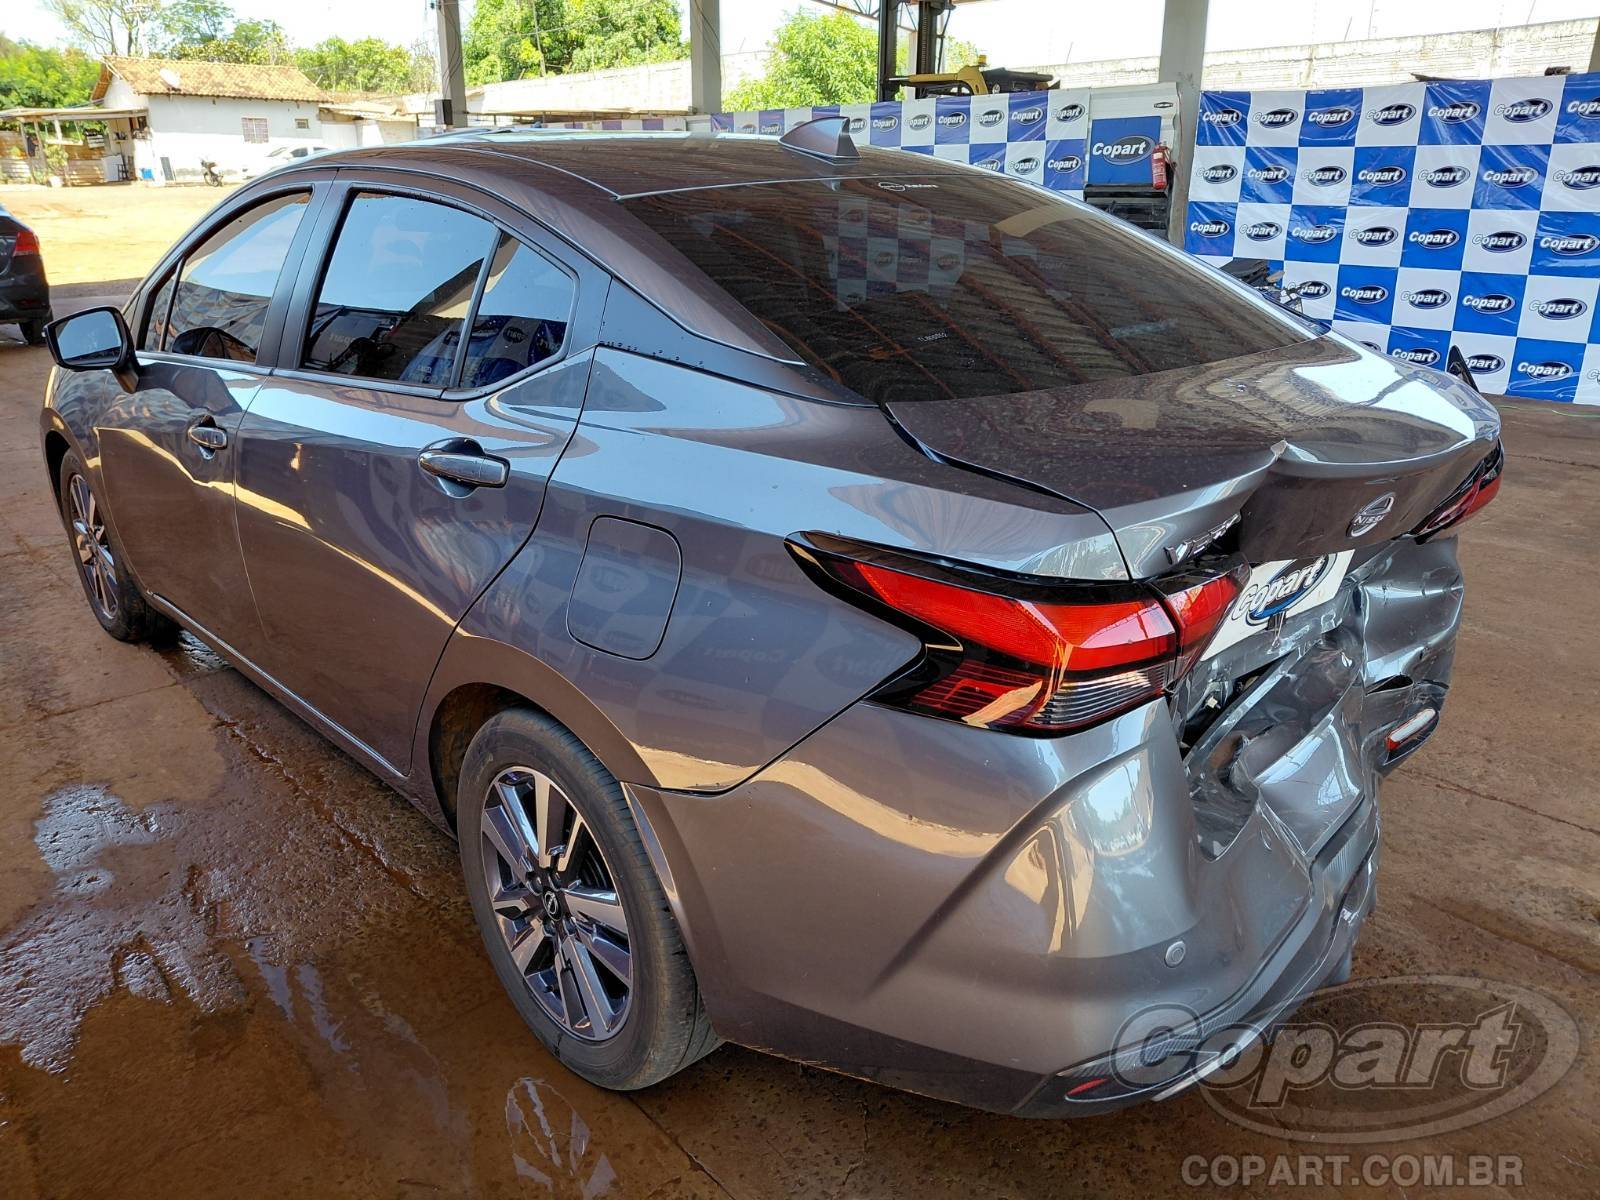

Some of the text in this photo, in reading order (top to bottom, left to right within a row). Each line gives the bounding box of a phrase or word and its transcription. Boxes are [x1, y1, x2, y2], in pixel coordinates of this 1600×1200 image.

[1011, 110, 1040, 123] Copart
[1052, 107, 1080, 120] Copart
[1202, 110, 1237, 124] Copart
[1253, 110, 1291, 124] Copart
[1308, 110, 1349, 124] Copart
[1366, 107, 1409, 122] Copart
[1428, 105, 1474, 121] Copart
[1494, 102, 1545, 119] Copart
[873, 119, 896, 129] Copart
[905, 118, 929, 128] Copart
[938, 114, 964, 126] Copart
[975, 112, 1003, 124] Copart
[1093, 141, 1146, 158] Copart
[1008, 158, 1039, 171] Copart
[1048, 157, 1078, 170] Copart
[1196, 167, 1232, 181] Copart
[1248, 166, 1285, 181] Copart
[1302, 167, 1341, 182] Copart
[1358, 168, 1400, 182] Copart
[1418, 169, 1462, 184] Copart
[1483, 169, 1531, 184] Copart
[1553, 169, 1600, 184] Copar
[1190, 222, 1225, 235] Copart
[1239, 223, 1276, 238] Copart
[1291, 225, 1332, 240] Copart
[1349, 228, 1392, 242] Copart
[1409, 230, 1453, 244] Copart
[1472, 233, 1519, 248] Copart
[1540, 236, 1593, 252] Copart
[1341, 286, 1383, 300] Copart
[1401, 290, 1445, 304] Copart
[1463, 295, 1509, 309] Copart
[1529, 300, 1579, 316] Copart
[1392, 348, 1435, 361] Copart
[1517, 361, 1567, 377] Copart
[1231, 554, 1326, 621] Copart
